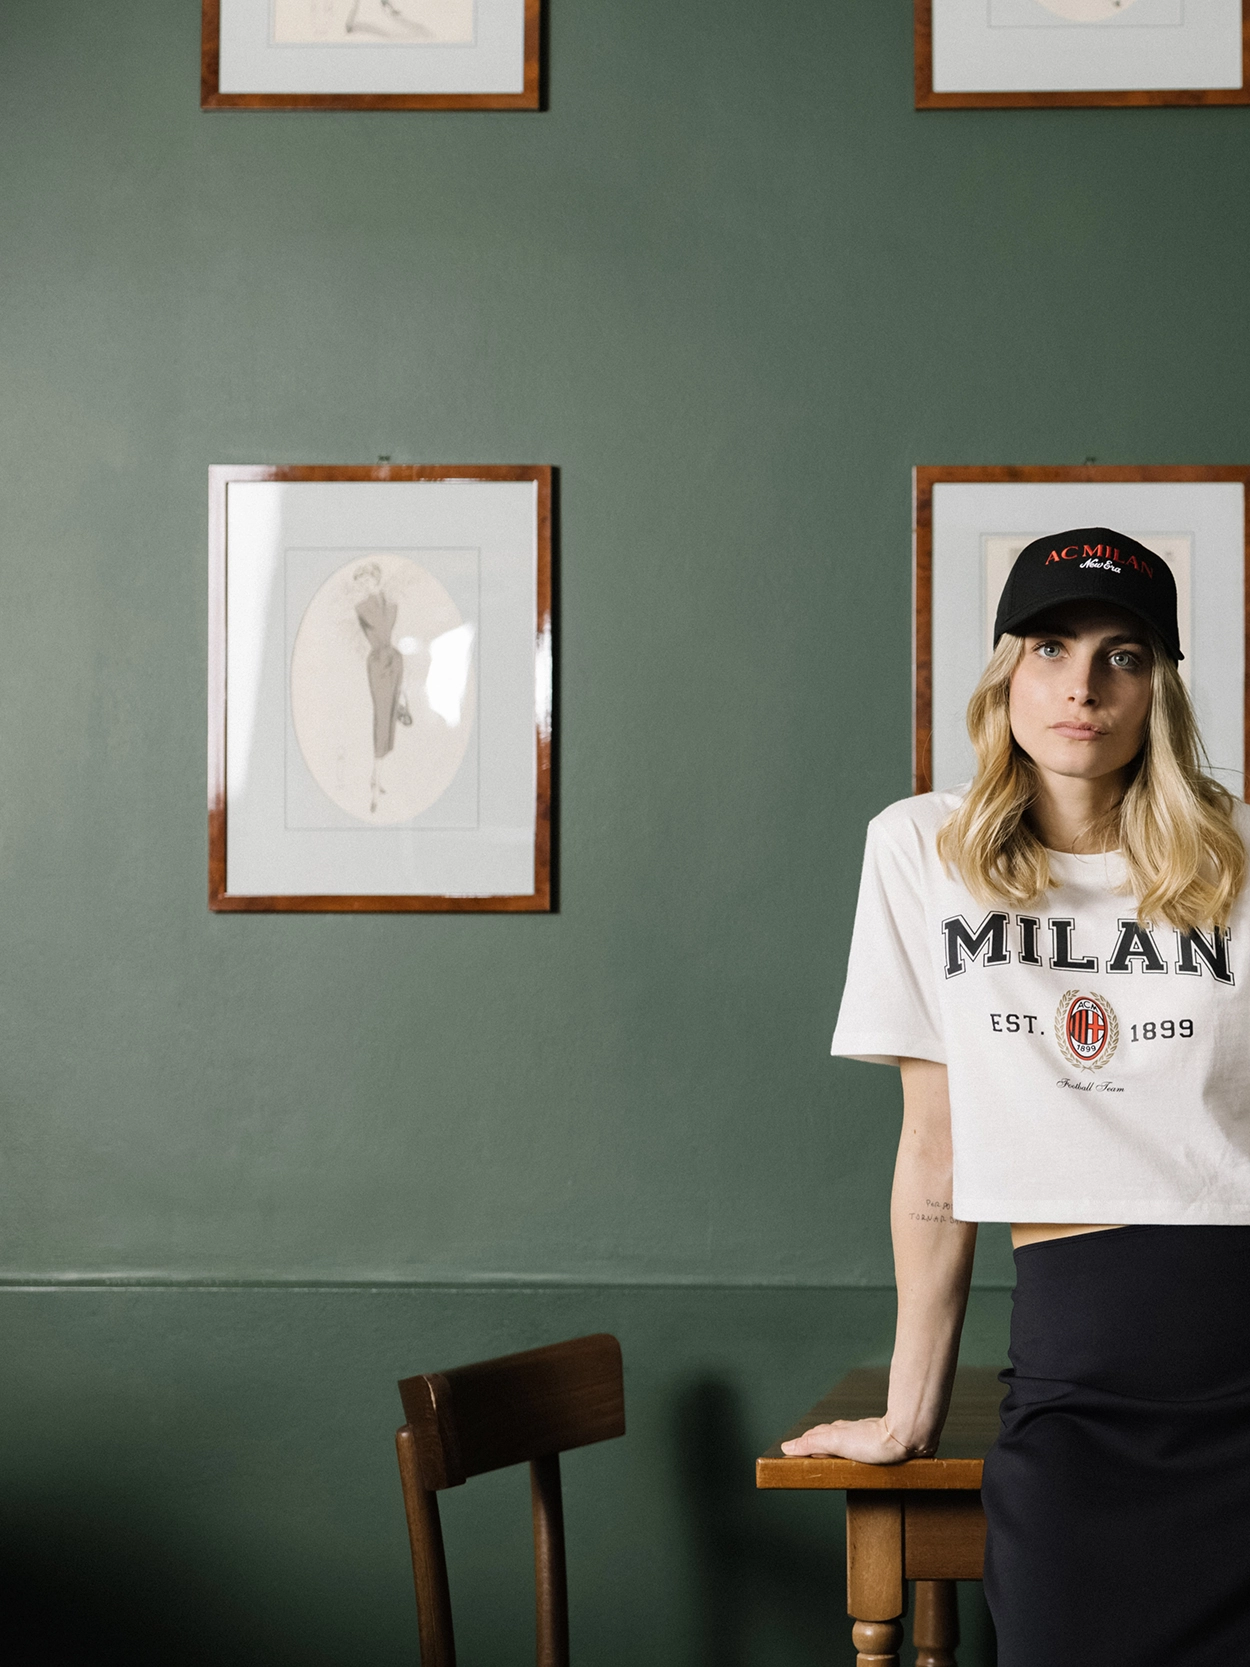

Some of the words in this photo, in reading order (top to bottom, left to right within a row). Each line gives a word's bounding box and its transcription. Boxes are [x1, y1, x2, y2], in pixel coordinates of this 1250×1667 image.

[1045, 545, 1079, 565] AC
[1082, 543, 1154, 579] MILAN
[1079, 558, 1102, 569] New
[1103, 560, 1122, 574] Era
[941, 910, 1236, 986] MILAN
[1076, 1000, 1099, 1013] ACM
[989, 1013, 1045, 1036] EST.
[1130, 1018, 1194, 1043] 1899
[1076, 1044, 1097, 1053] 1899
[1056, 1077, 1095, 1091] Football
[1095, 1081, 1125, 1093] Team
